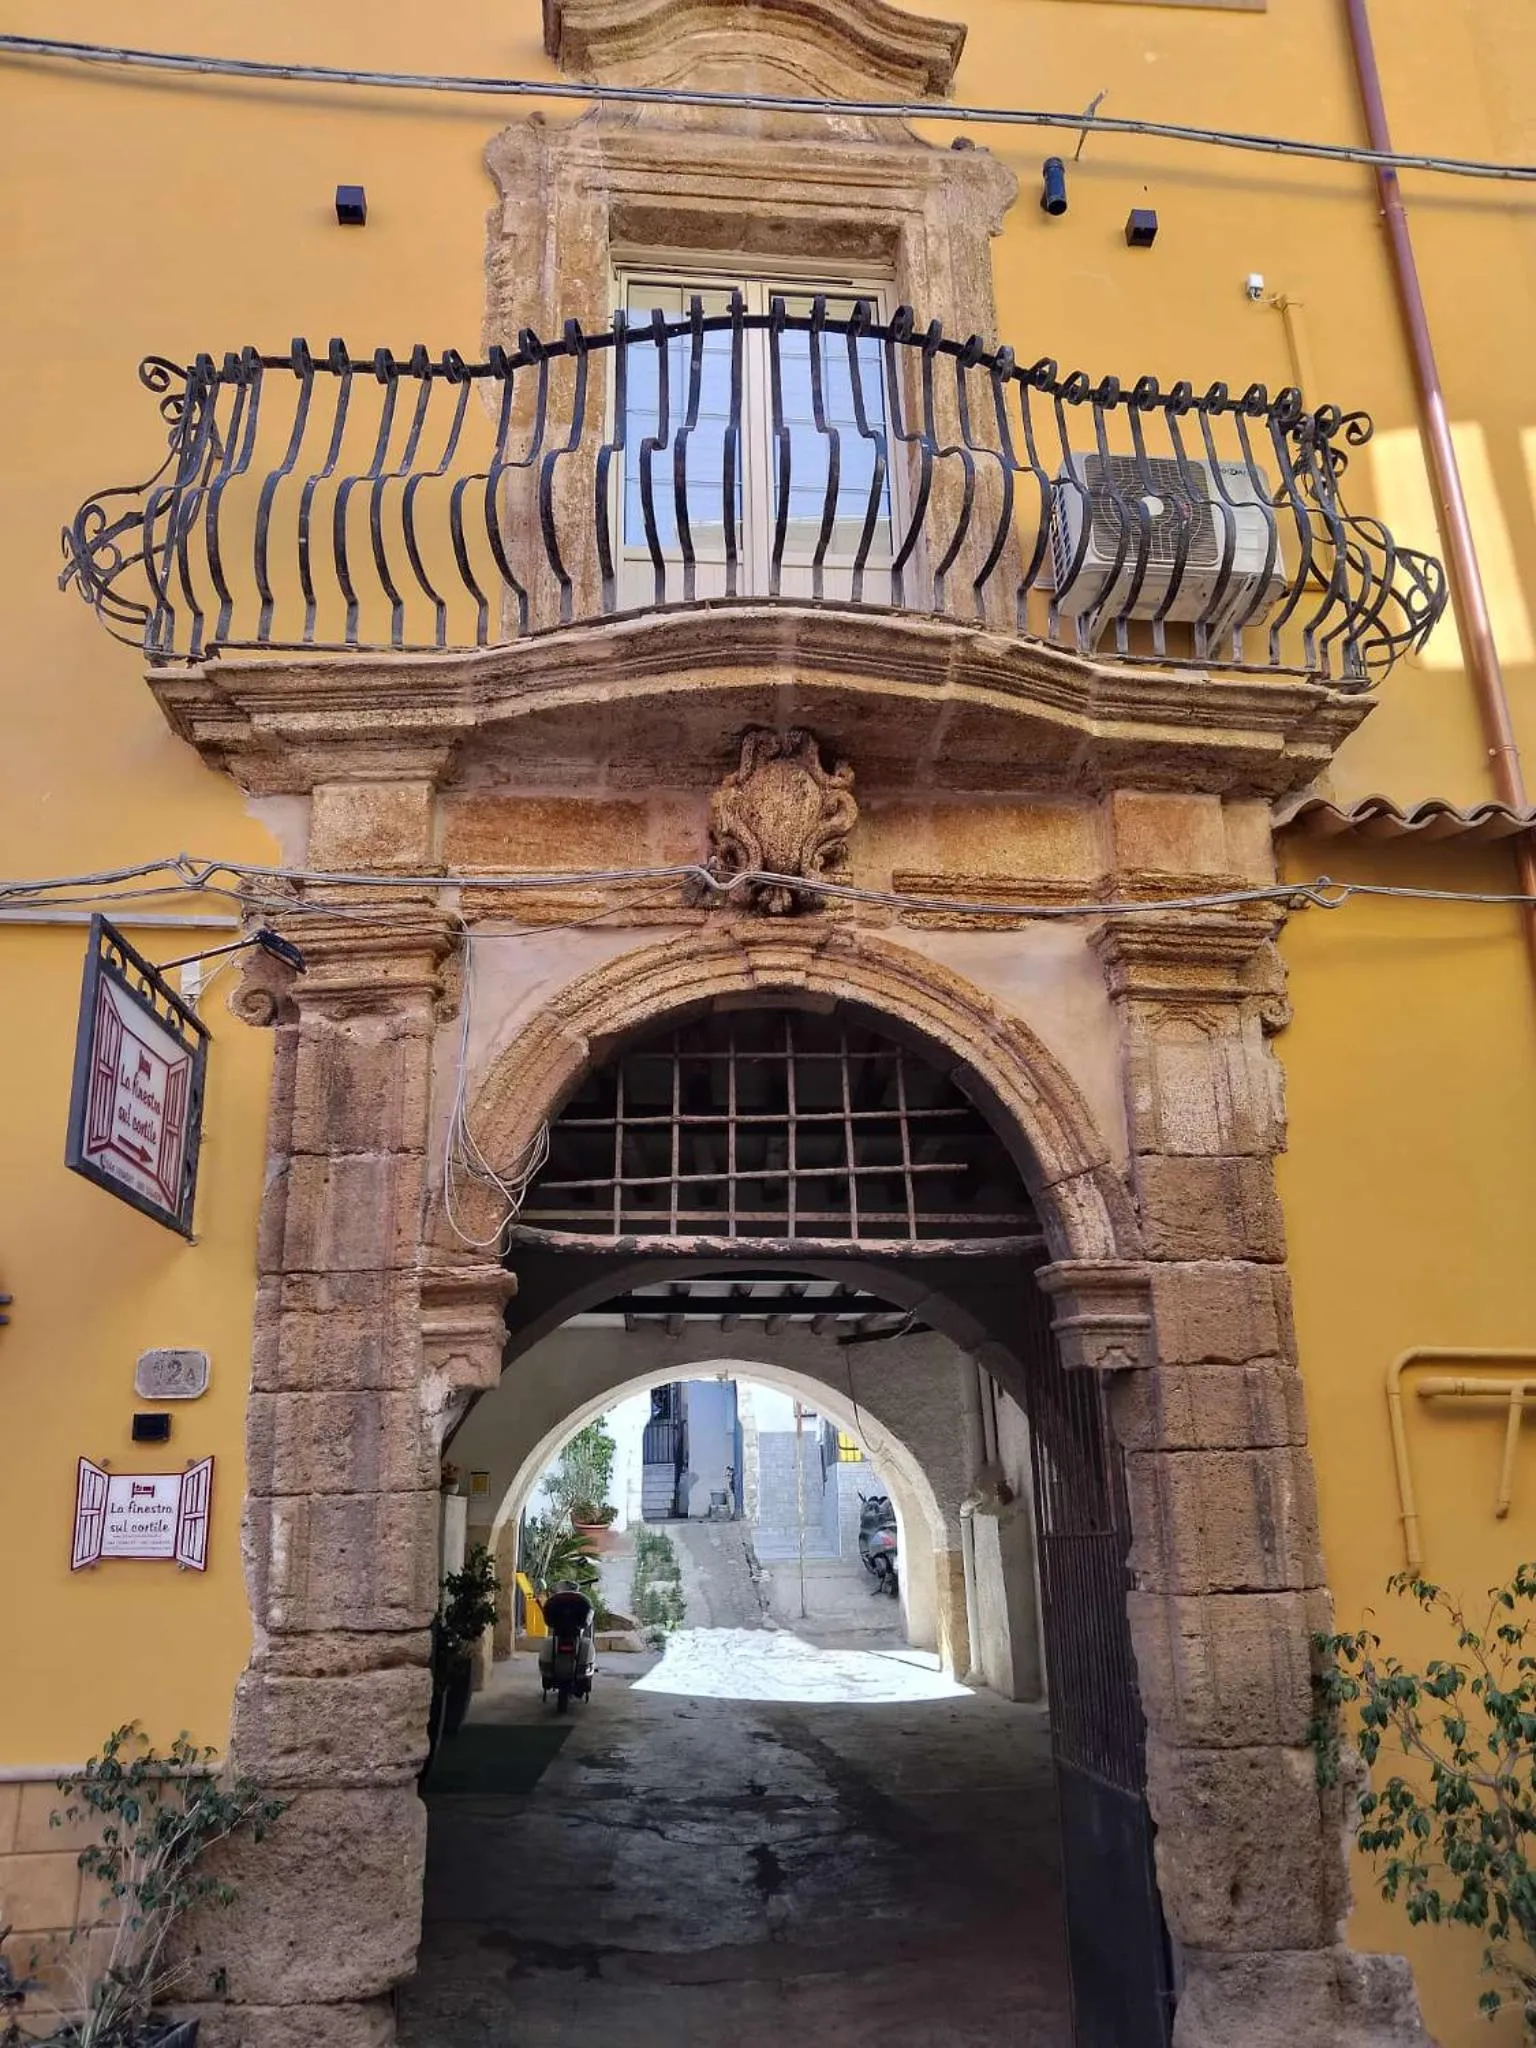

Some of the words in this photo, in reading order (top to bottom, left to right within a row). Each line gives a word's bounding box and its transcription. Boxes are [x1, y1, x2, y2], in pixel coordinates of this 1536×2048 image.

[120, 1063, 131, 1091] La
[131, 1071, 162, 1116] finestra
[118, 1103, 132, 1127] sul
[131, 1116, 157, 1145] cortile
[110, 1502, 124, 1514] La
[128, 1500, 174, 1514] finestra
[110, 1519, 128, 1533] sul
[131, 1519, 170, 1533] cortile
